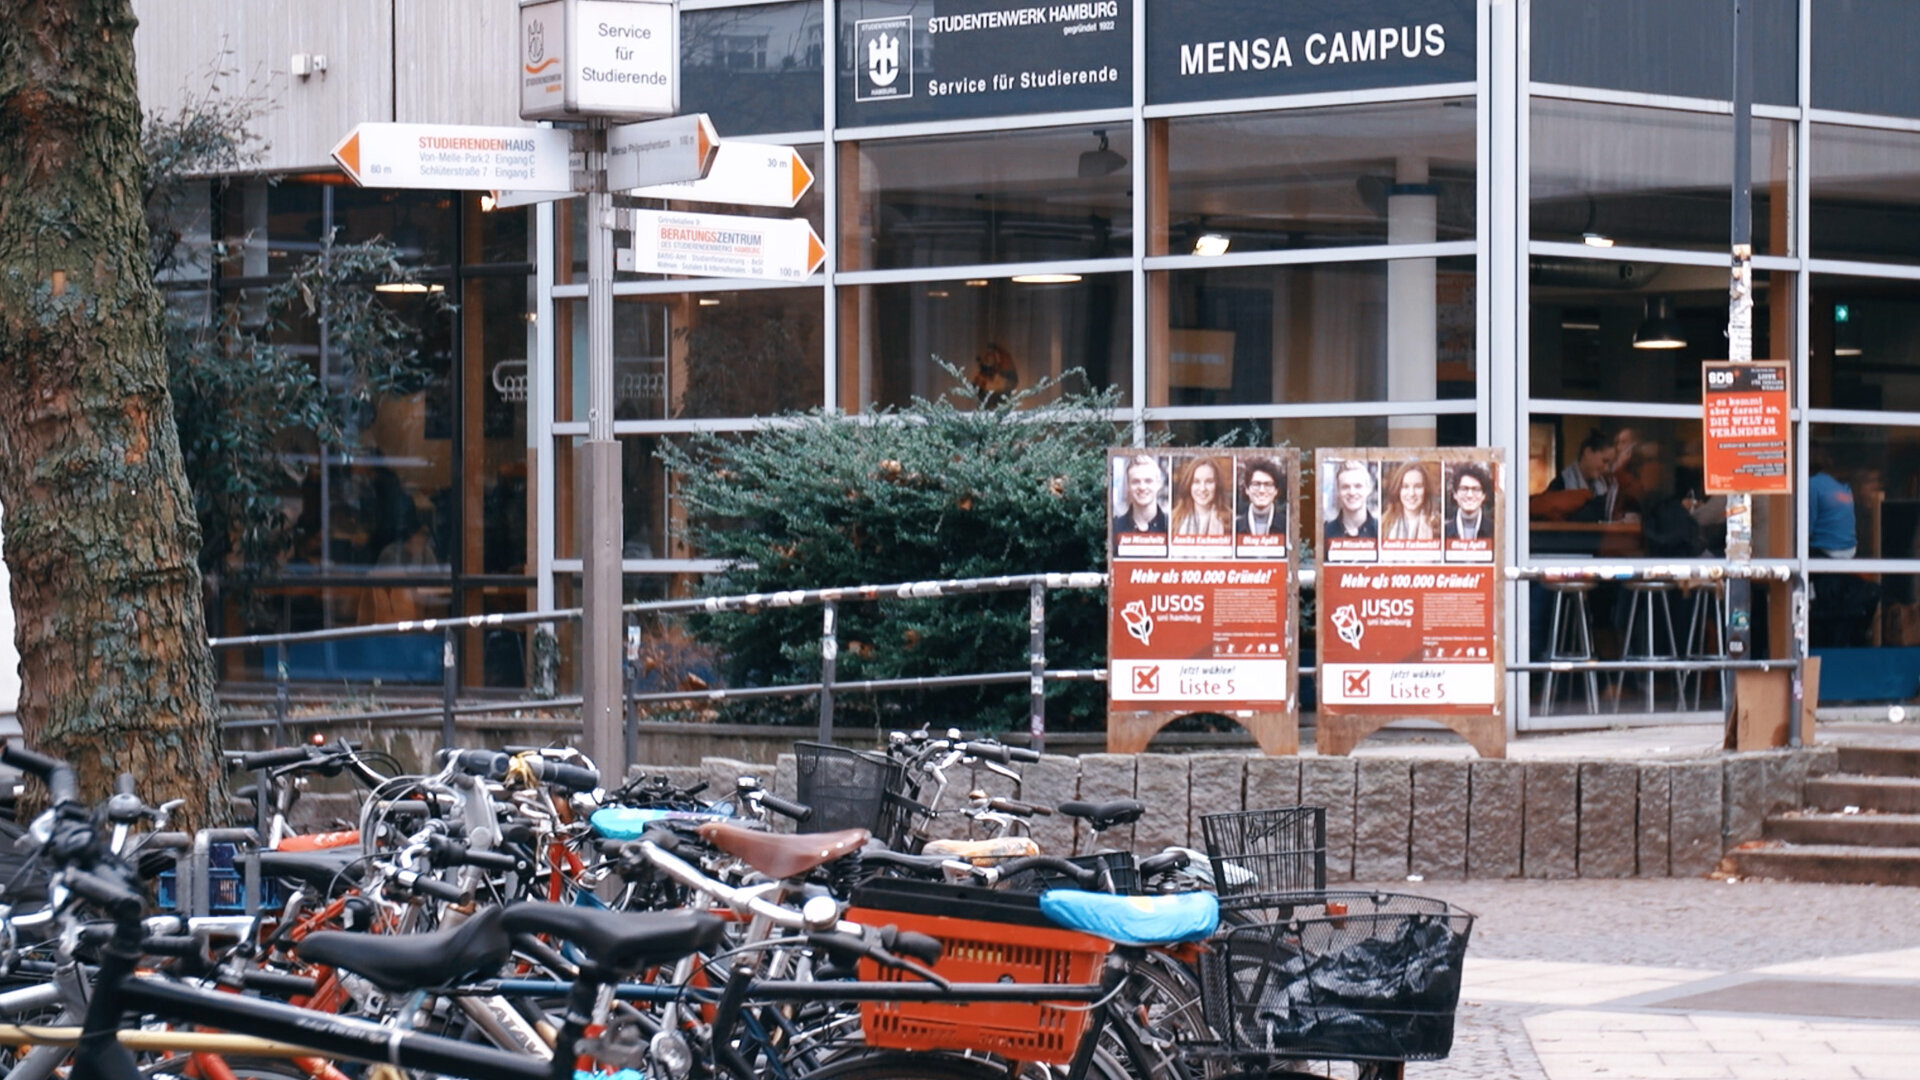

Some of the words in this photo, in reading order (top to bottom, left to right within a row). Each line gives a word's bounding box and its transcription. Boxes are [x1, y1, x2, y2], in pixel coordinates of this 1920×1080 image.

[928, 8, 1046, 33] STUDENTENWERK
[1050, 0, 1118, 23] HAMBURG
[598, 23, 651, 39] Service
[1063, 24, 1097, 36] gegründet
[1099, 21, 1115, 31] 1922
[615, 46, 634, 60] für
[1180, 36, 1293, 75] MENSA
[1305, 23, 1446, 65] CAMPUS
[582, 67, 667, 85] Studierende
[928, 77, 986, 96] Service
[993, 74, 1015, 91] für
[1020, 66, 1118, 89] Studierende
[419, 136, 535, 151] STUDIERENDENHAUS
[495, 154, 528, 166] Eingang
[767, 158, 777, 167] 30
[420, 165, 480, 177] Schlüterstraße
[495, 167, 528, 179] Eingang
[530, 168, 535, 178] E
[661, 228, 761, 246] BERATUNGSZENTRUM
[780, 267, 792, 276] 100
[1708, 371, 1734, 384] SDS
[1710, 416, 1729, 427] DIE
[1731, 415, 1763, 425] WELT
[1130, 568, 1160, 584] Mehr
[1161, 569, 1179, 584] als
[1181, 569, 1226, 584] 100.000
[1340, 573, 1371, 588] Mehr
[1372, 574, 1389, 589] als
[1391, 574, 1434, 588] 100.000
[1150, 594, 1204, 613] JUSOS
[1361, 599, 1414, 618] JUSOS
[1156, 614, 1168, 623] uni
[1169, 613, 1202, 624] hamburg
[1379, 618, 1412, 628] hamburg
[1180, 678, 1221, 695] Liste
[1227, 679, 1235, 695] 5
[1390, 682, 1431, 699] Liste
[1437, 683, 1446, 699] 5
